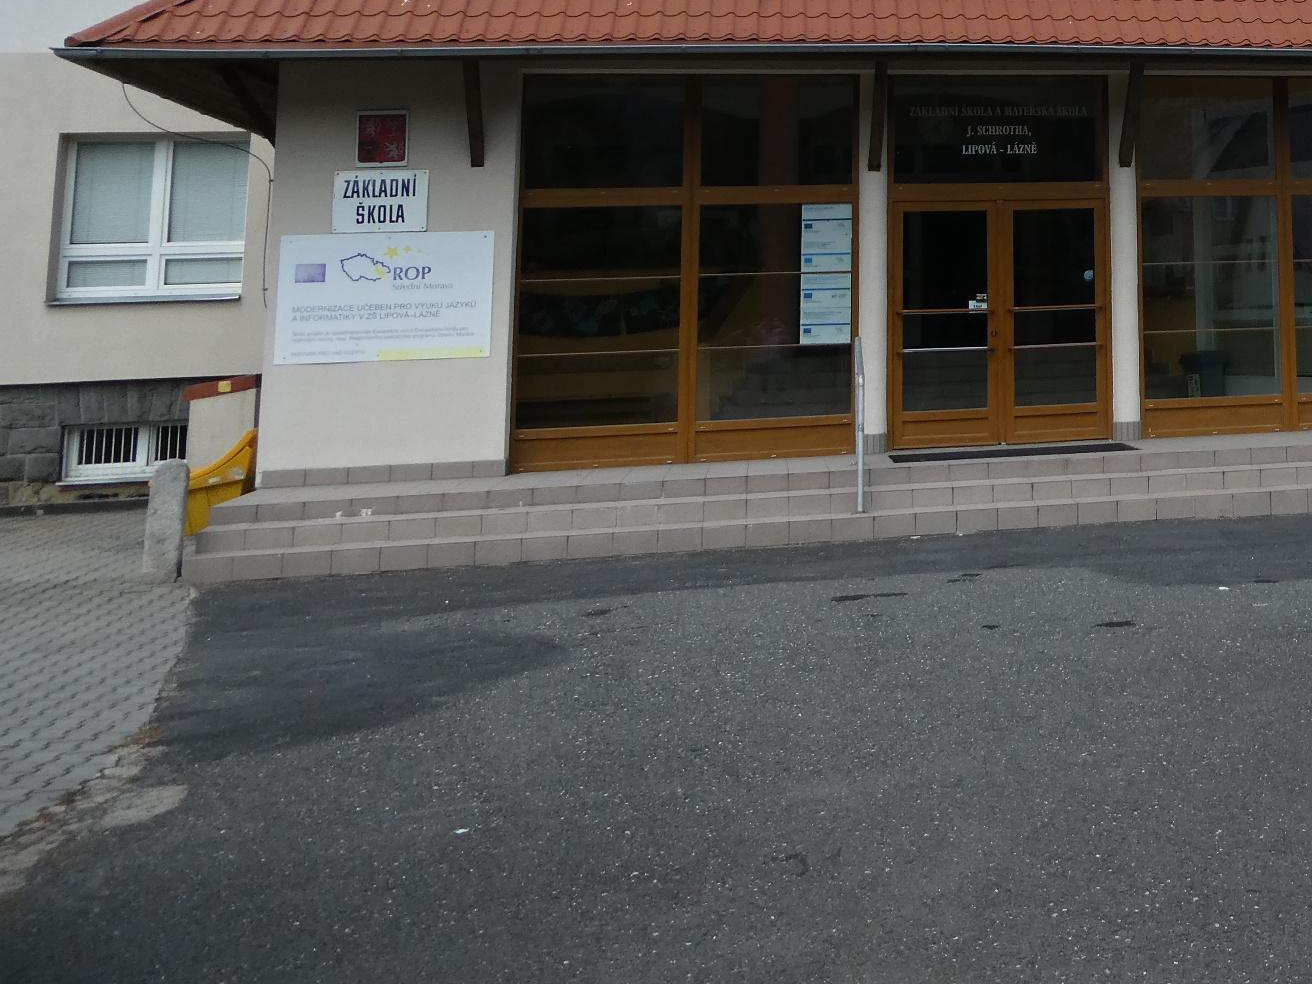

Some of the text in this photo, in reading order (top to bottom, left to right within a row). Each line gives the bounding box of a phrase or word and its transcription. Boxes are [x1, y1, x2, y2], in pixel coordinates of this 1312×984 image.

[966, 125, 1032, 137] J. SCHROTHA,
[962, 141, 997, 155] LIPOVÁ
[1007, 141, 1038, 154] LÁZNĚ
[342, 173, 417, 199] ZÁKLADNÍ
[356, 201, 405, 224] ŠKOLA
[393, 266, 432, 281] ROP
[291, 304, 355, 314] MODERNIZACE
[394, 302, 413, 311] PRO
